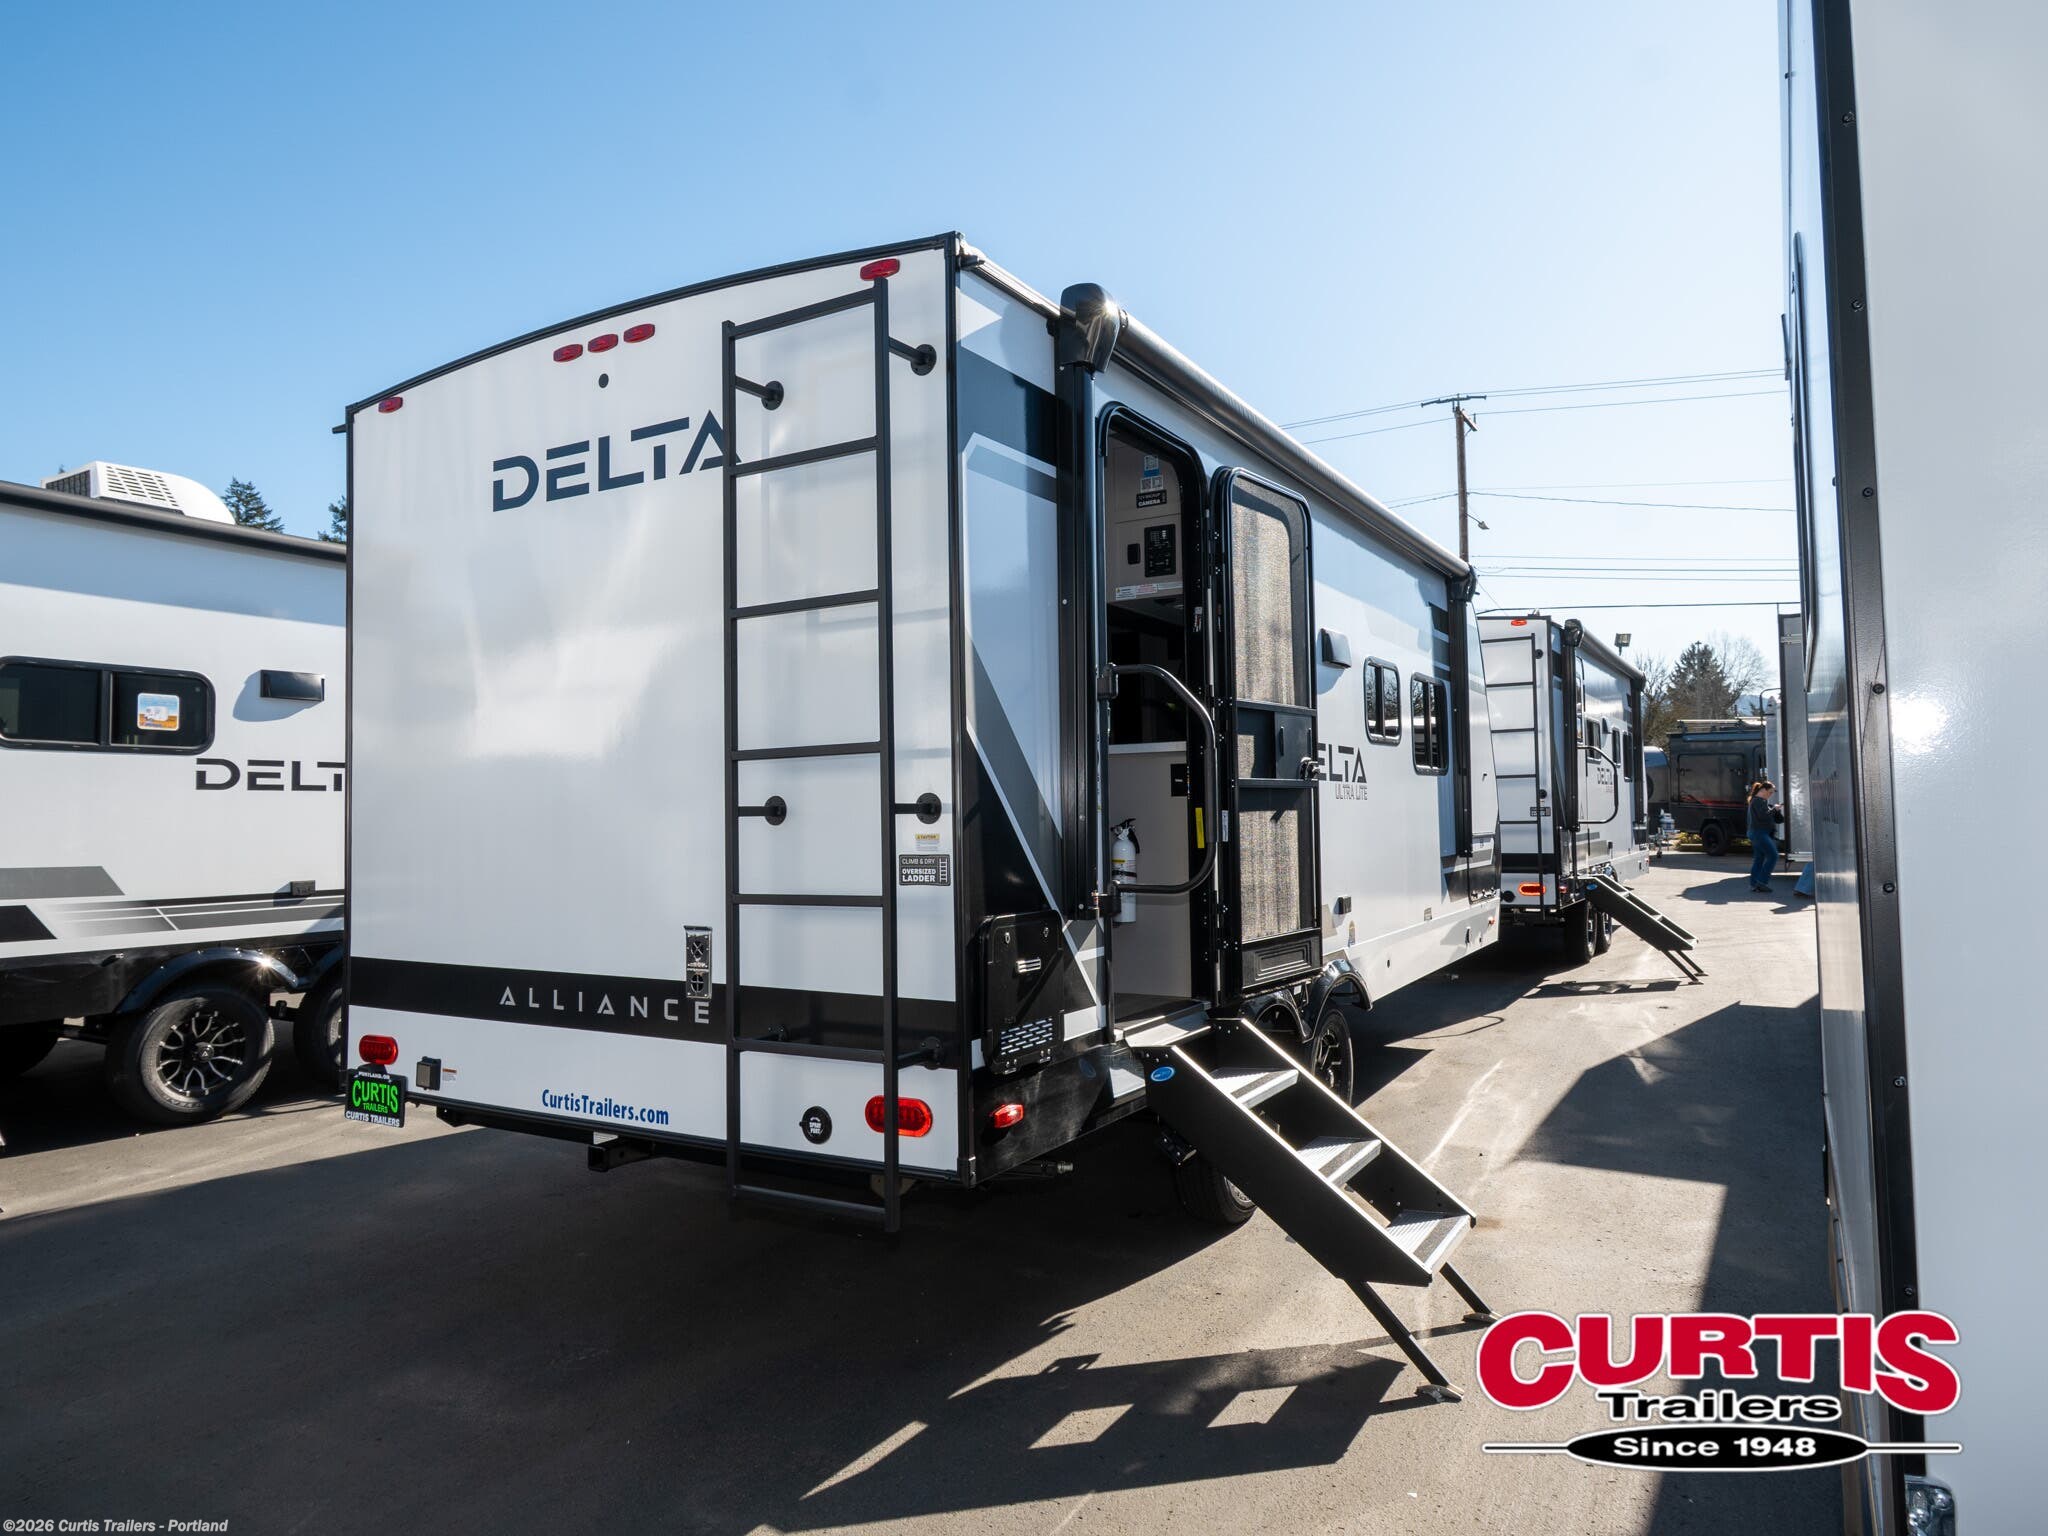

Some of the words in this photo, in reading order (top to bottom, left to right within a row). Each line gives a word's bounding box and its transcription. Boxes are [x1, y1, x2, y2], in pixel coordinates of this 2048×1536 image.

[493, 409, 742, 512] DELTA
[902, 874, 936, 882] LADDER
[499, 985, 709, 1025] ALLIANCE
[352, 1080, 398, 1113] CURTIS
[363, 1102, 388, 1114] TRAILERS
[542, 1089, 669, 1125] CurtisTrailers.com
[345, 1110, 369, 1122] CURTIS
[370, 1114, 400, 1127] TRAILERS
